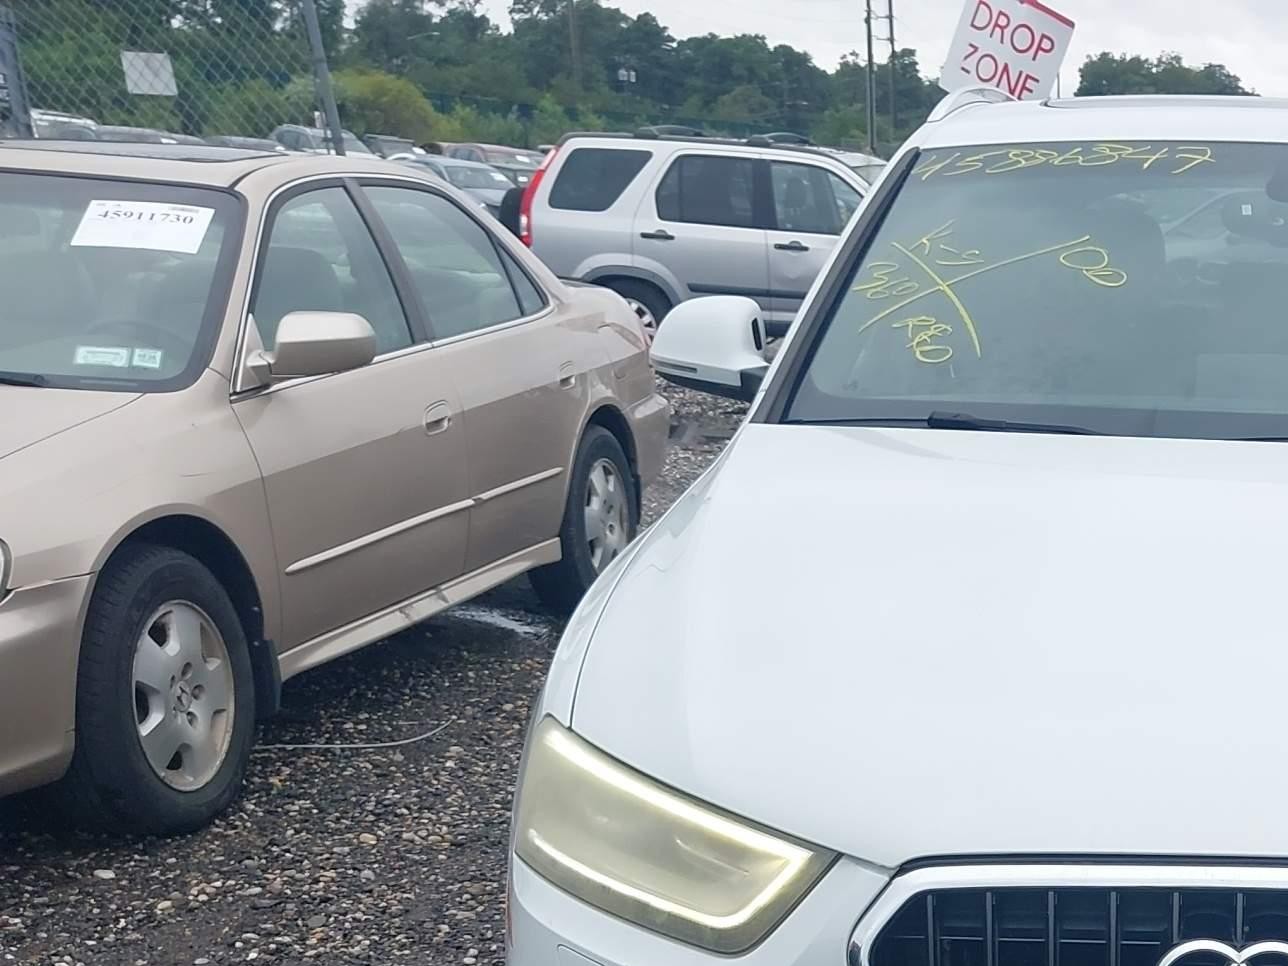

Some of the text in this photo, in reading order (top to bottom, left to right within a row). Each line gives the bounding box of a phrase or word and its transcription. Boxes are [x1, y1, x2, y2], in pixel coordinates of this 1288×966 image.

[970, 0, 1055, 61] DROP
[961, 43, 1040, 100] ZONE
[98, 209, 194, 225] 45911730
